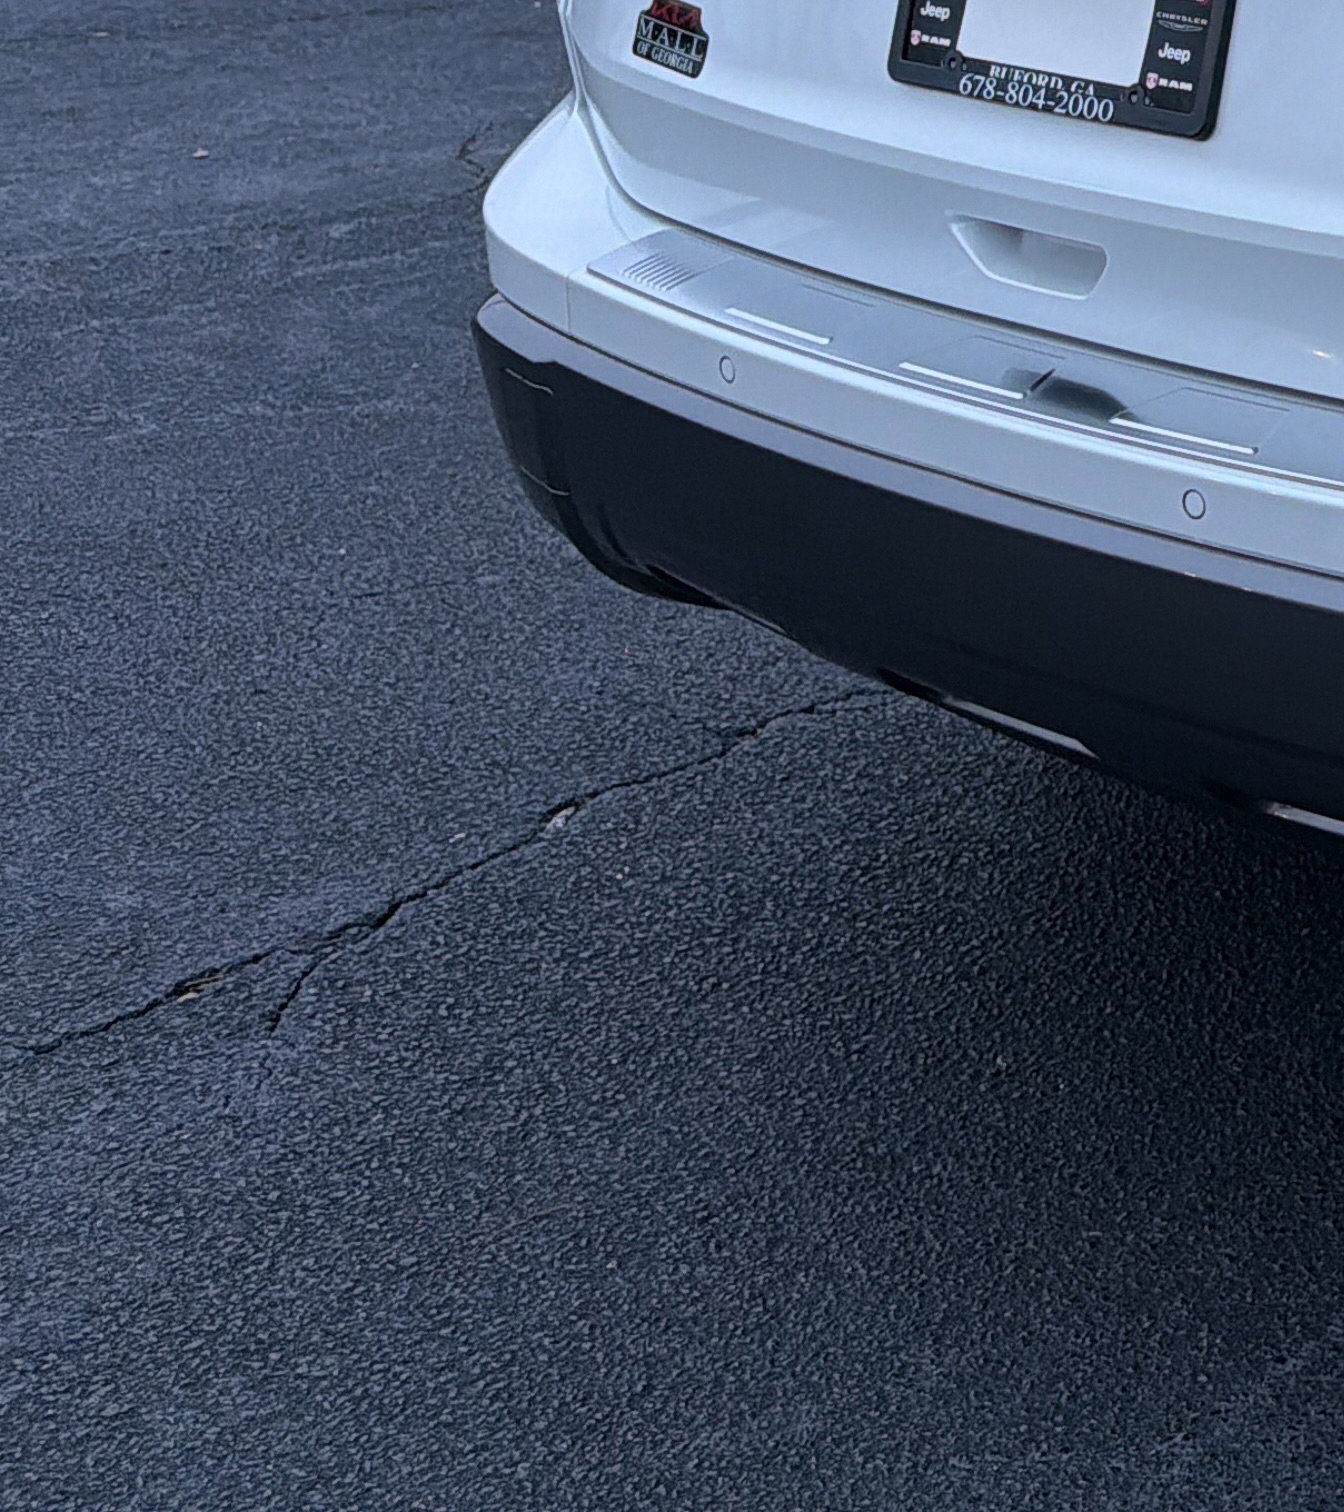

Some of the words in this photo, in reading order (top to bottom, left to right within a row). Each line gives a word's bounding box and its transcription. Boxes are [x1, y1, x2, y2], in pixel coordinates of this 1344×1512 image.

[920, 0, 951, 22] Jeep
[1156, 10, 1209, 26] CHRYSLER
[921, 33, 952, 47] RAM
[636, 40, 651, 57] OF
[651, 46, 694, 75] GEORGIA
[1158, 42, 1191, 65] Jeep
[1158, 77, 1193, 92] RAM
[959, 72, 1114, 122] 678-804-2000
